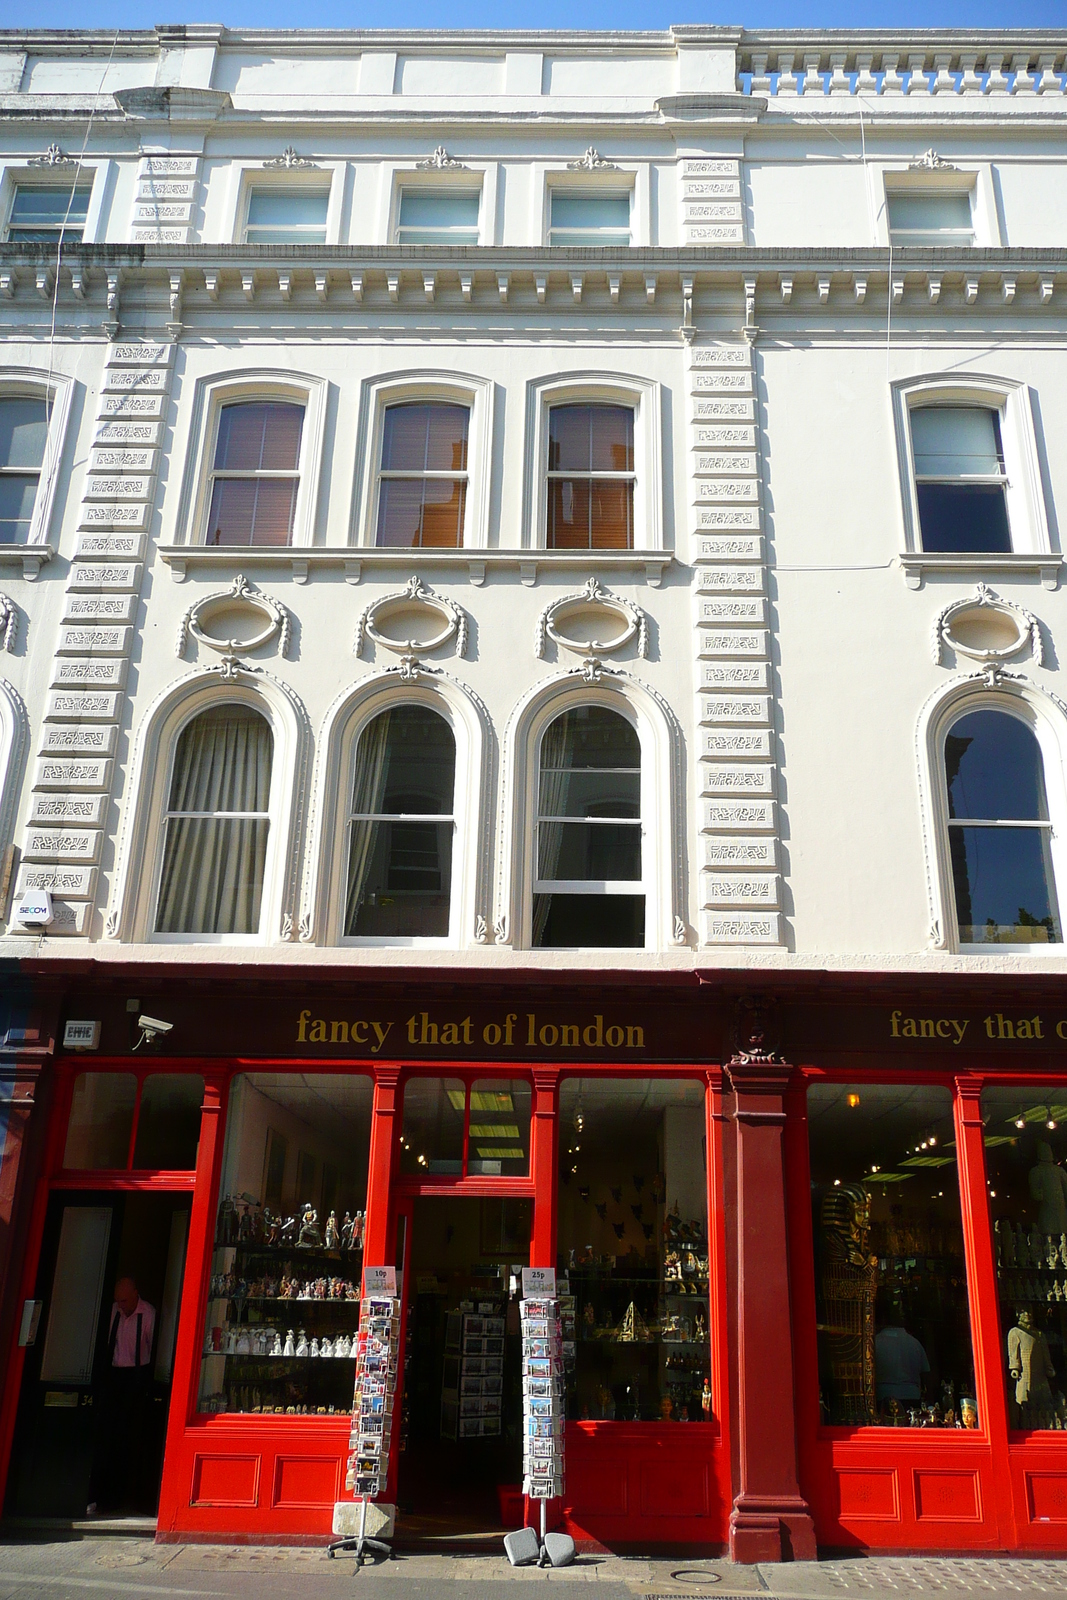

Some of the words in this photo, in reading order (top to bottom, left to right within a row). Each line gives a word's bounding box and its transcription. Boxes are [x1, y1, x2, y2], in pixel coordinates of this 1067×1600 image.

[295, 1009, 395, 1052] fancy
[405, 1012, 474, 1045] that
[482, 1013, 518, 1046] of
[526, 1014, 645, 1048] london
[889, 1010, 970, 1045] fancy
[983, 1013, 1045, 1039] that
[375, 1270, 387, 1278] 10p
[531, 1271, 545, 1279] 25p
[81, 1395, 94, 1406] 34
